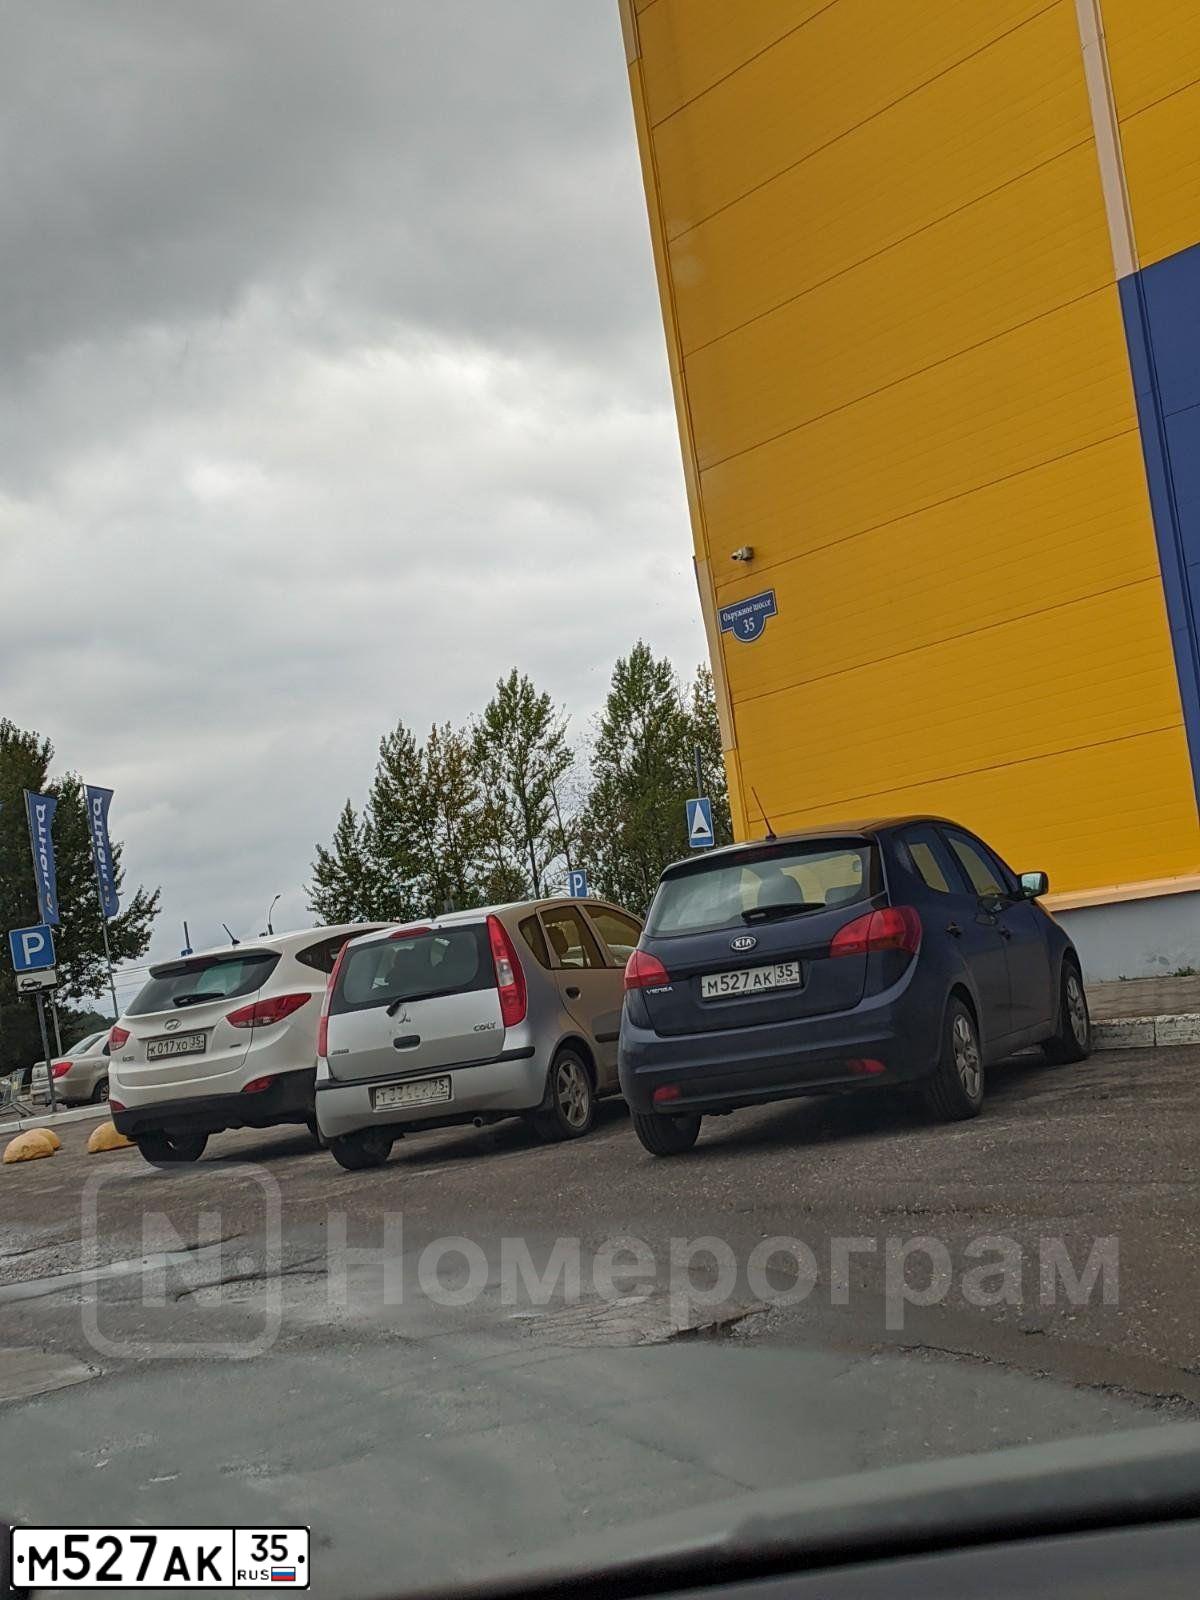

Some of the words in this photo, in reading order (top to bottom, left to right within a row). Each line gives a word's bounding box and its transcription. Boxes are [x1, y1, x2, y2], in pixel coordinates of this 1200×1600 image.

[742, 617, 755, 634] 35
[573, 874, 583, 897] P
[21, 932, 45, 965] P
[734, 938, 753, 949] KIA
[776, 964, 793, 979] 35
[473, 1021, 496, 1032] COLT
